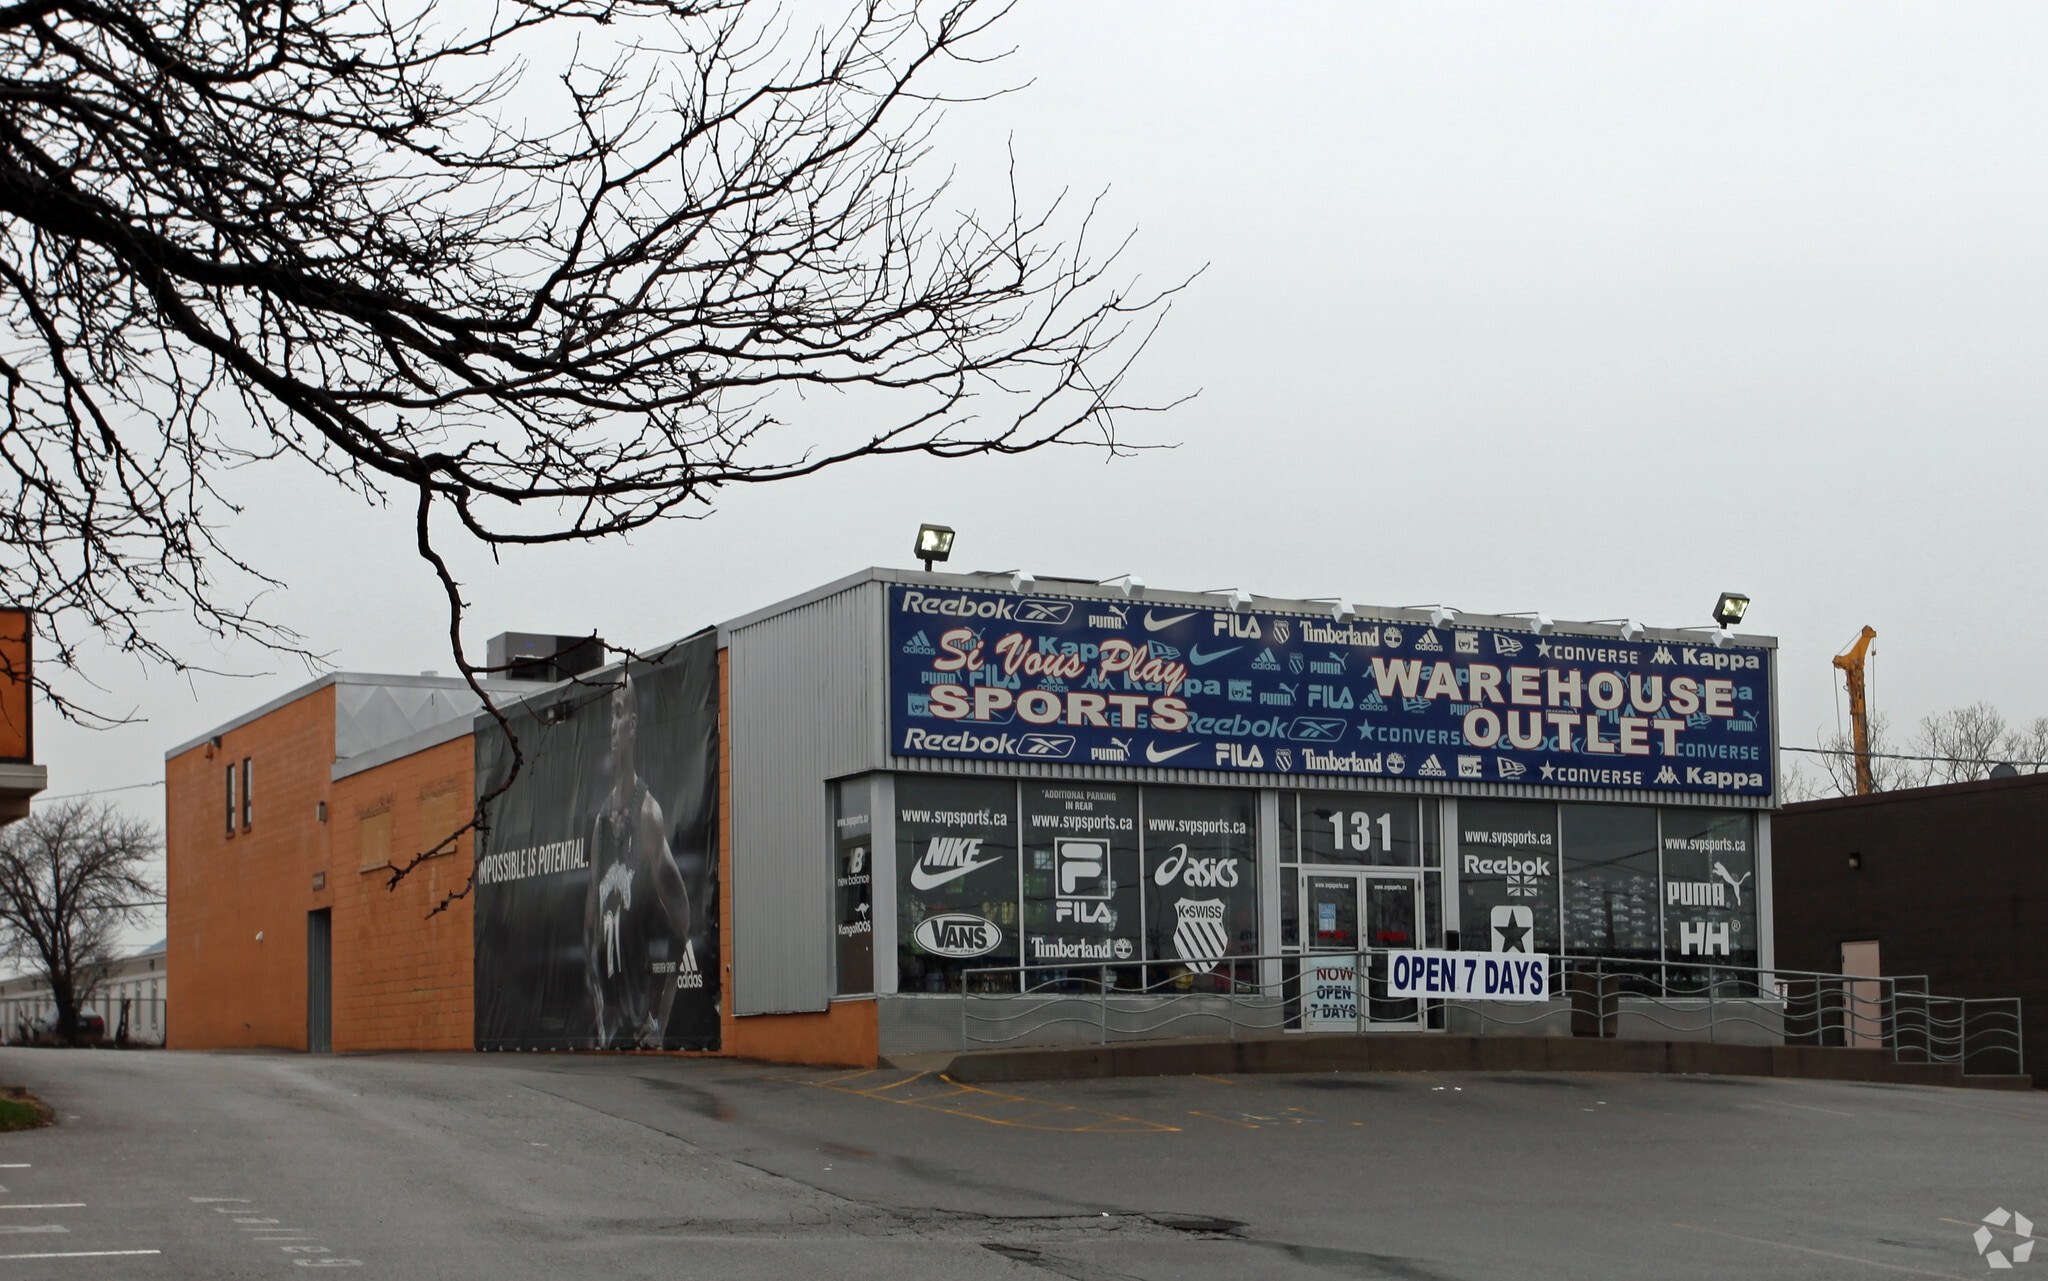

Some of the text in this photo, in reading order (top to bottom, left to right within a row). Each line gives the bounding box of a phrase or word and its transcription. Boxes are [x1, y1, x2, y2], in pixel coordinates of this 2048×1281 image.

[901, 591, 1015, 620] Reebok
[1088, 615, 1122, 629] PUMA
[1213, 613, 1262, 639] FILA
[1299, 620, 1380, 647] Timberland
[903, 644, 936, 655] adidas
[1415, 641, 1443, 652] adidas
[1554, 645, 1638, 664] CONVERSE
[933, 627, 984, 671] Si
[995, 631, 1086, 678] Vous
[1099, 638, 1187, 697] Play
[1251, 661, 1281, 671] adidas
[1310, 661, 1342, 675] PUMA
[1682, 647, 1760, 671] Kappa
[921, 671, 957, 684] PUMA
[1371, 656, 1734, 717] WAREHOUSE
[1259, 692, 1291, 706] PUMA
[1308, 684, 1354, 710] FILA
[929, 684, 1189, 731] SPORTS
[1359, 702, 1388, 712] adidas
[1463, 708, 1685, 756] OUTLET
[1726, 719, 1754, 732] PUMA
[904, 728, 1017, 755] Reebok
[1676, 742, 1759, 760] CONVERSE
[1091, 747, 1125, 762] PUMA
[1215, 742, 1264, 768] FILA
[1302, 747, 1383, 774] Timberland
[1418, 766, 1446, 777] adidas
[1557, 767, 1641, 785] CONVERSE
[1686, 766, 1763, 790] Kappa
[1065, 802, 1093, 811] IN REAR
[1086, 792, 1117, 802] PARKING
[902, 809, 1008, 828] www.svpsports.ca
[1031, 814, 1133, 832] www.svpsports.ca
[1148, 818, 1246, 836] www.svpsports.ca
[1328, 811, 1392, 851] 131
[1465, 830, 1552, 847] www.svpsports.ca
[923, 837, 984, 867] NIKE
[1665, 837, 1746, 854] www.svpsports.ca
[527, 848, 537, 877] IS
[538, 838, 589, 876] POTENTIAL.
[1464, 855, 1550, 876] Reebok
[1183, 857, 1239, 888] asics
[1666, 881, 1725, 907] PUMA
[1056, 901, 1112, 923] FILA
[931, 919, 987, 949] VANS
[1680, 921, 1730, 956] HH
[1031, 936, 1111, 959] Timberland
[677, 970, 703, 989] adidas
[1316, 966, 1354, 981] NOW
[1393, 955, 1544, 995] OPEN 7 DAYS
[1316, 985, 1351, 1000] OPEN
[1310, 1003, 1357, 1019] 7 DAYS
